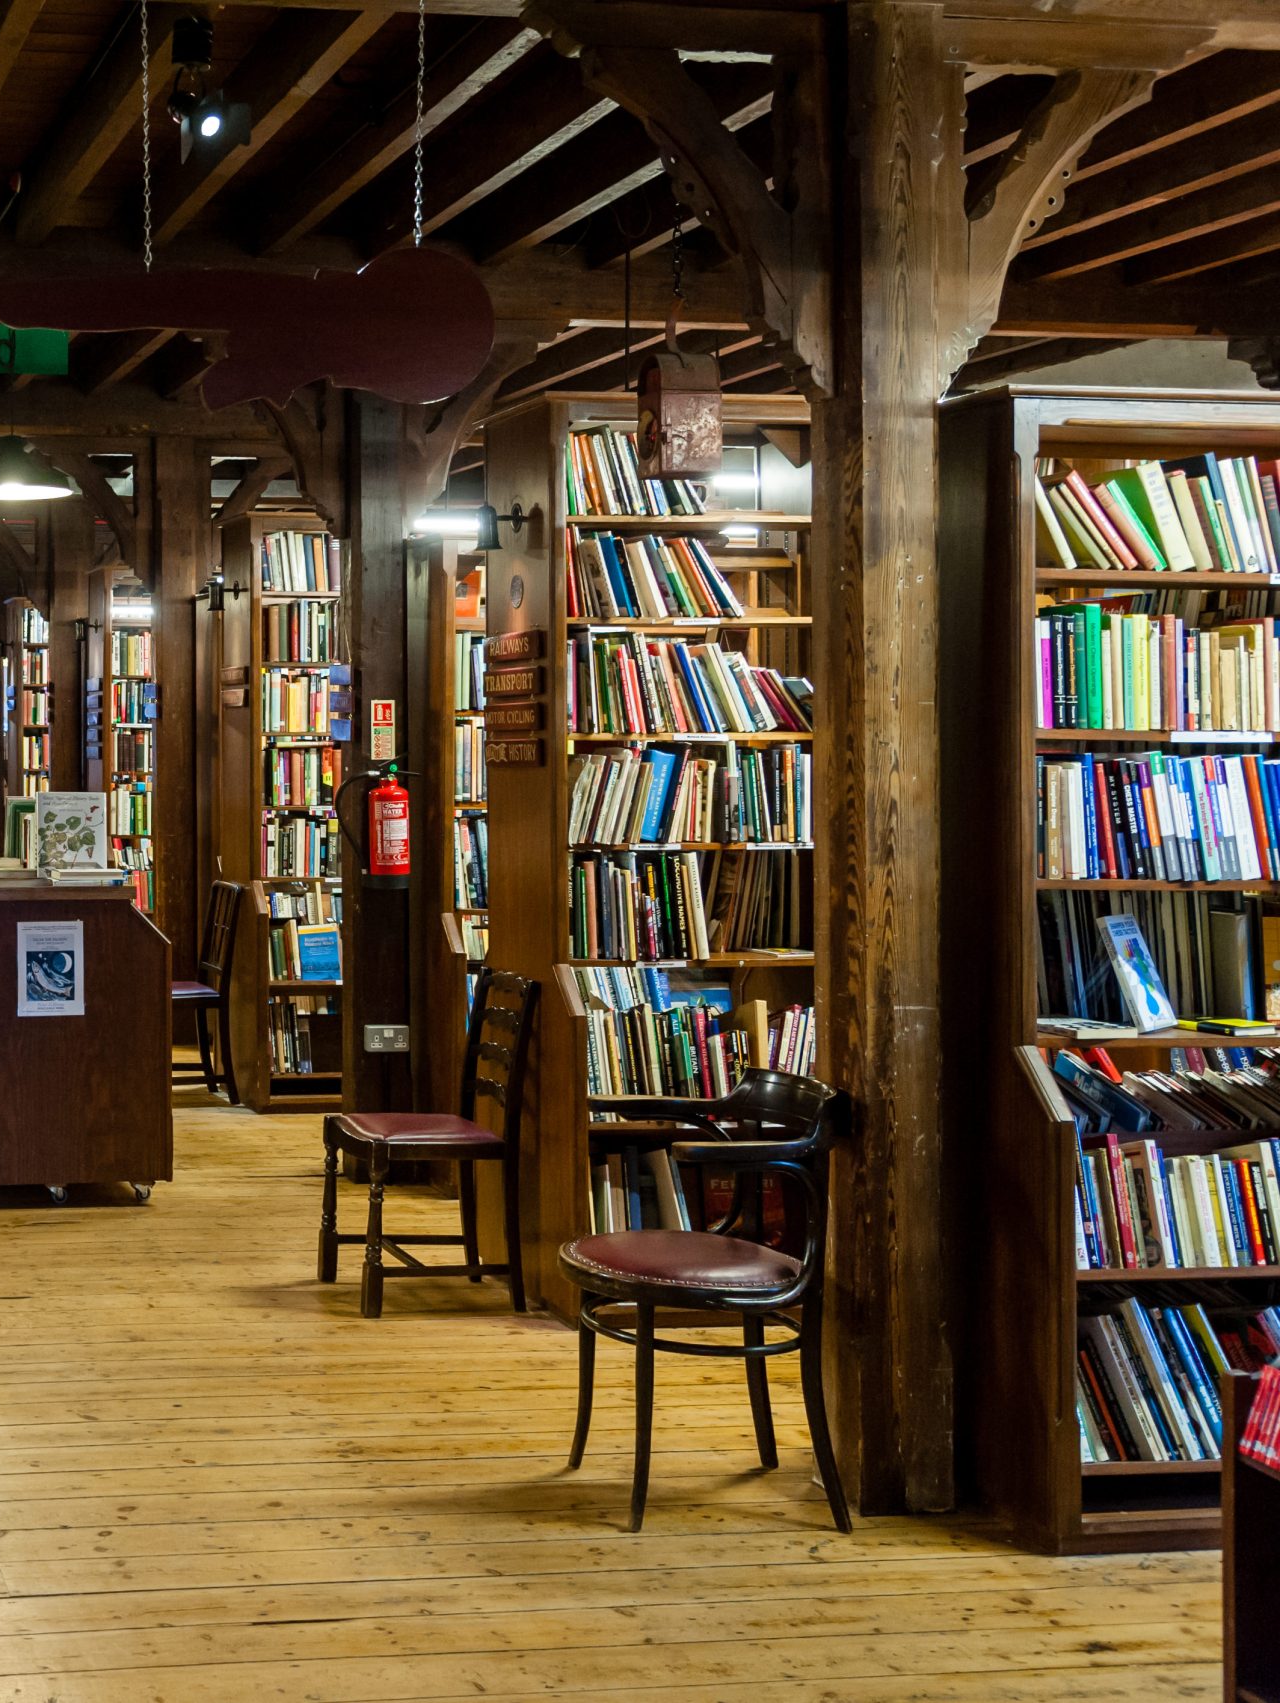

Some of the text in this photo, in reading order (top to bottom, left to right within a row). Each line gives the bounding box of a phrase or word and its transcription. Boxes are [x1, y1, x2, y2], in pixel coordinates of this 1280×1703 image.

[490, 637, 529, 657] RAILWAYS
[1089, 646, 1097, 665] Chess
[485, 672, 534, 692] TRANSPORT
[1089, 667, 1097, 696] Openings
[506, 709, 535, 724] CYCLING
[508, 743, 536, 762] HISTORY
[1048, 781, 1056, 806] Complete
[650, 796, 661, 827] RAILWAYS
[1110, 791, 1122, 825] SYSTEM
[1122, 784, 1137, 834] CHESS MASTER
[672, 857, 686, 930] LOCOMOTIVE NAMES
[689, 1045, 699, 1073] BRITAIN
[1231, 1223, 1242, 1248] MEDICINE
